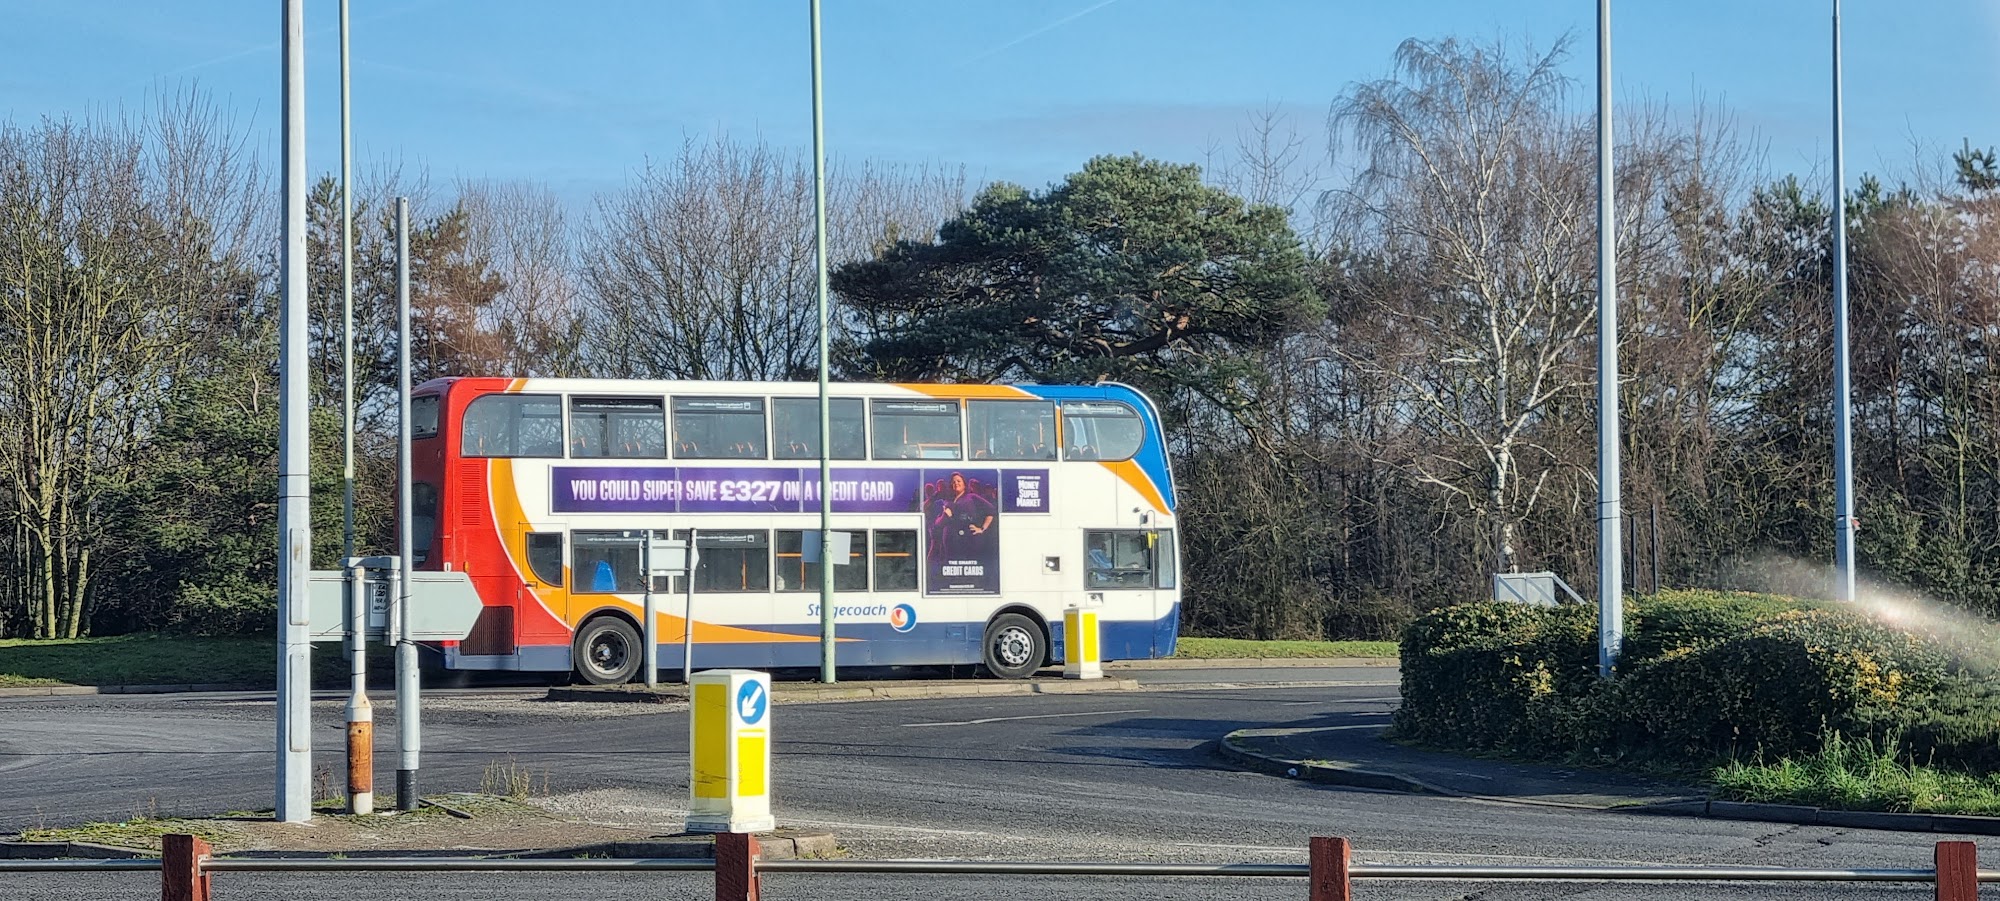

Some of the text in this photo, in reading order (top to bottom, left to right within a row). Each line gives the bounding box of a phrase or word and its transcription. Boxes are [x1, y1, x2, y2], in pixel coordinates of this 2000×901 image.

[571, 479, 597, 501] YOU
[600, 479, 640, 501] COULD
[643, 480, 682, 501] SUPER
[686, 480, 717, 501] SAVE
[719, 480, 781, 502] £327
[783, 480, 800, 501] ON
[804, 480, 813, 501] A
[861, 480, 894, 501] CARD
[1016, 497, 1041, 507] MARKET
[942, 566, 984, 576] CREDIT CARDS
[807, 603, 887, 619] Stgecoach
